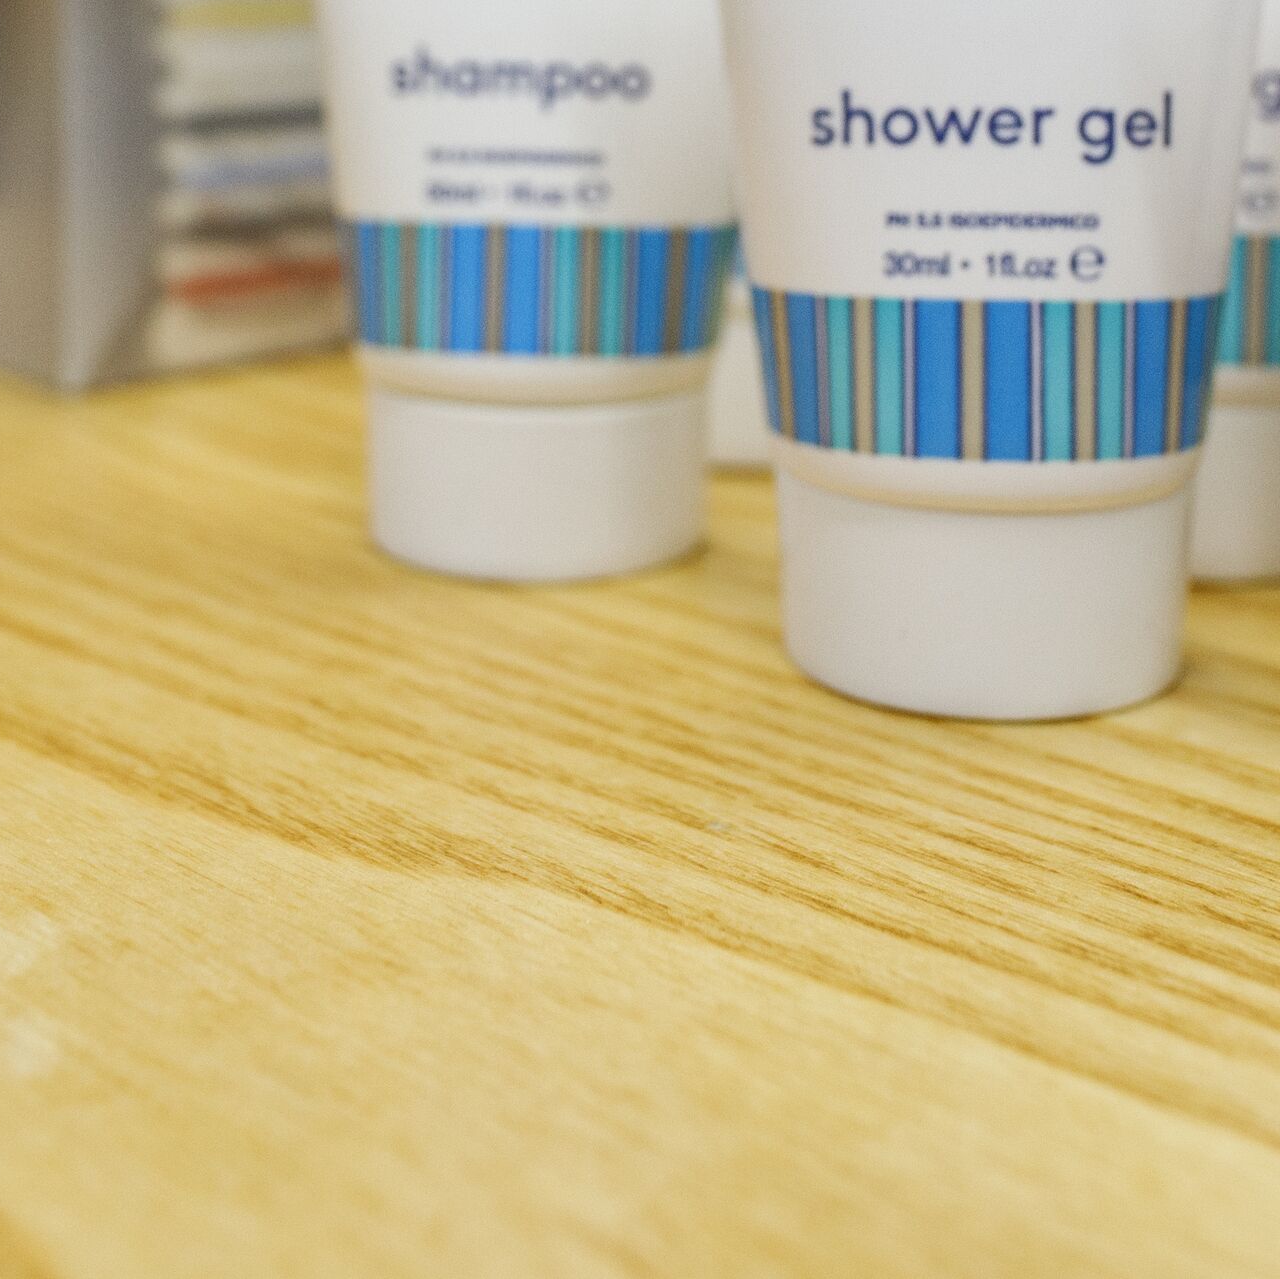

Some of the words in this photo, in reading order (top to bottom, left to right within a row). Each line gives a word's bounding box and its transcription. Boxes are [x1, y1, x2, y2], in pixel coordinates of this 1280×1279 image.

[389, 45, 656, 112] shampoo
[810, 88, 1057, 149] shower
[1076, 89, 1176, 167] gel
[882, 250, 952, 279] 30ml
